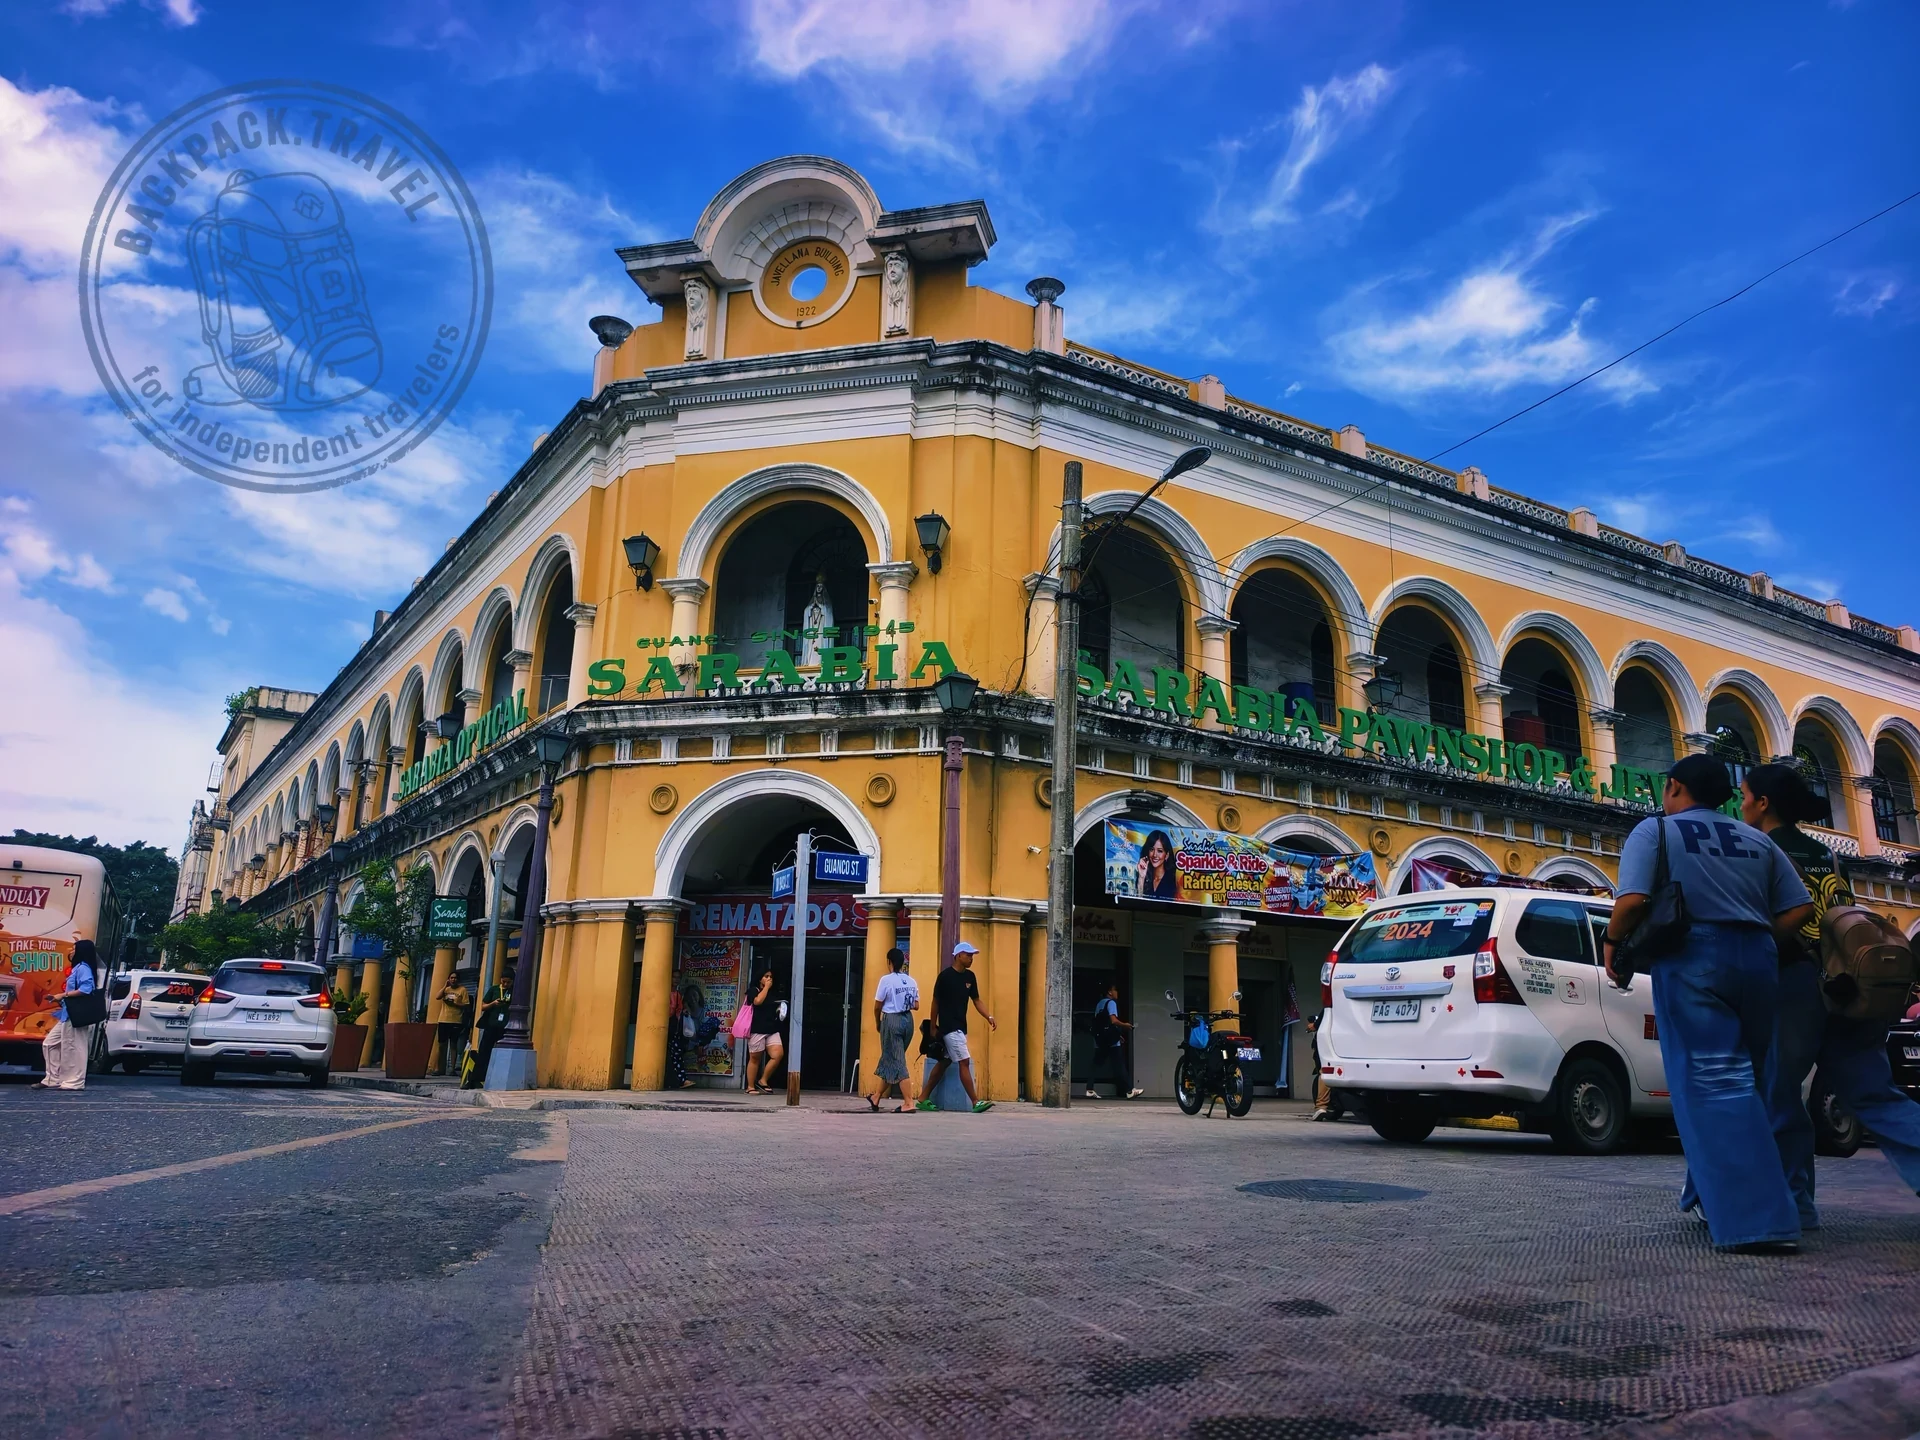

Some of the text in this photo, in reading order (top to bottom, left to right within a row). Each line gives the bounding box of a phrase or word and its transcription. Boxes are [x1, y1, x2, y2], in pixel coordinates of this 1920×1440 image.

[771, 246, 844, 286] JAVELLANA BUILDING
[796, 306, 816, 317] 1922
[751, 626, 841, 644] SINCE
[587, 641, 958, 696] SARABIA
[1077, 649, 1328, 742] SARABIA
[1338, 707, 1565, 787] PAWNSHOP
[1570, 756, 1598, 795] &
[399, 687, 528, 800] SARABIA OPTICAL
[1183, 837, 1216, 852] Sarabia
[1672, 819, 1760, 860] P.E.
[824, 858, 860, 876] GUANCO ST.
[1176, 852, 1269, 873] Sparkle & Ride
[1821, 866, 1832, 874] TO
[63, 878, 75, 888] 21
[1183, 875, 1260, 891] Raffle Fiesta
[1328, 874, 1359, 889] LUCKY
[1213, 893, 1226, 903] BUY
[1329, 888, 1361, 903] DRAW
[434, 904, 467, 920] Sarabia
[689, 902, 843, 931] REMATADO
[1077, 931, 1120, 942] JEWELRY
[1383, 920, 1435, 941] 2024
[9, 940, 57, 952] TAKE YOUR
[691, 942, 728, 956] Sarabia
[11, 951, 64, 974] SHOT!
[167, 985, 194, 996] 2240
[247, 1013, 260, 1021] NEI
[1395, 1004, 1418, 1017] 4079
